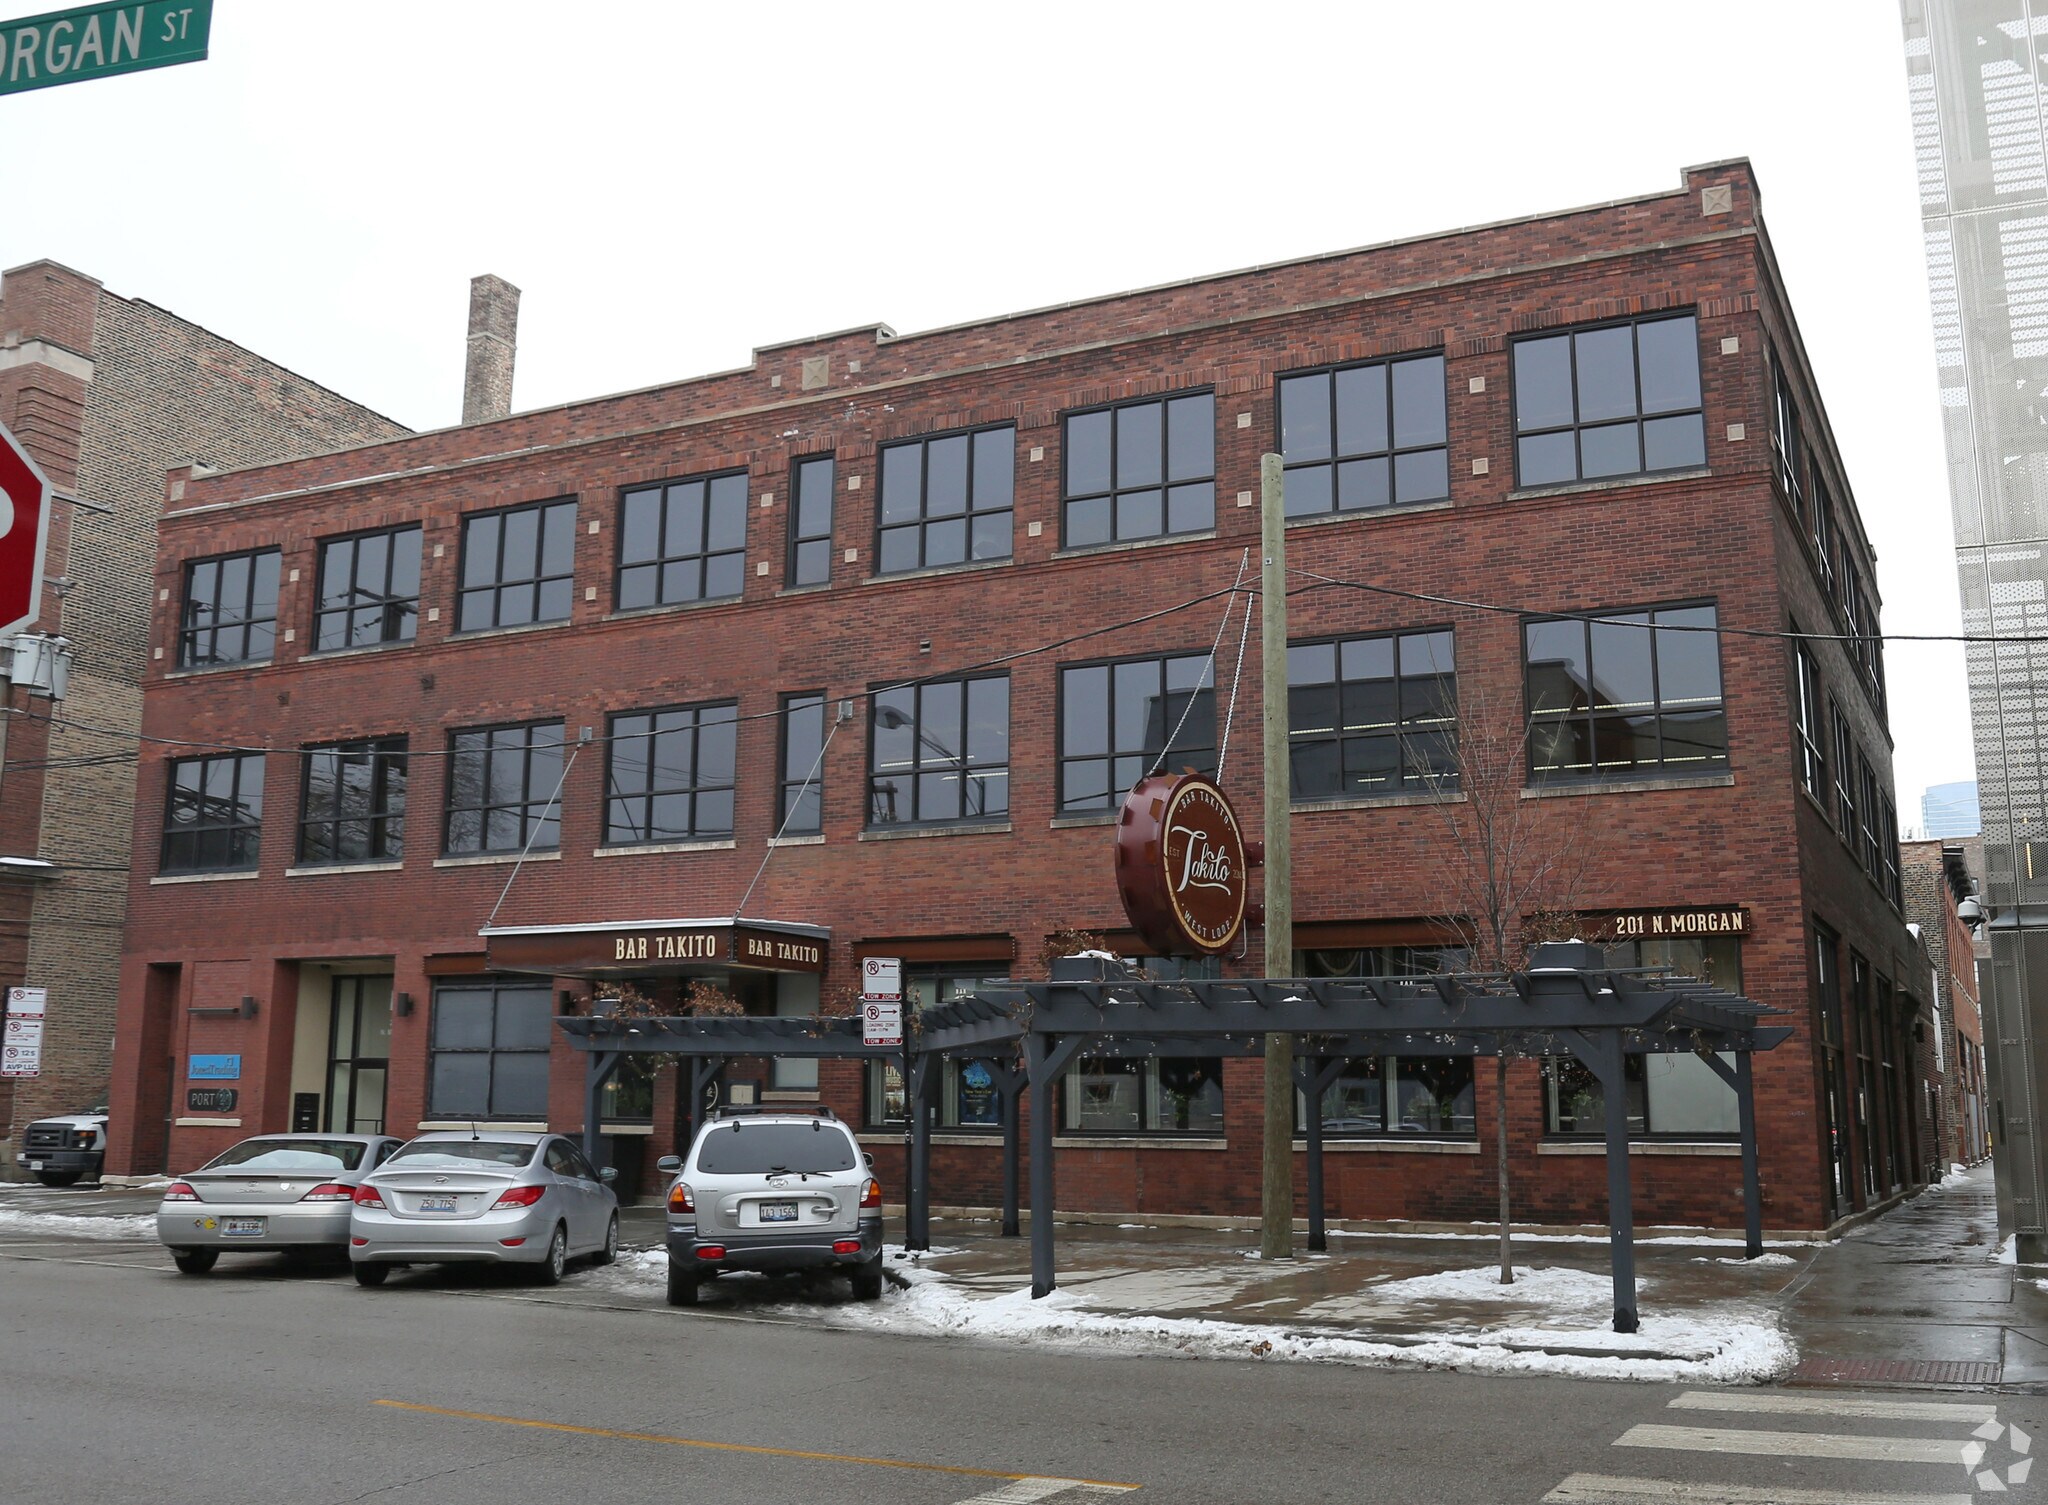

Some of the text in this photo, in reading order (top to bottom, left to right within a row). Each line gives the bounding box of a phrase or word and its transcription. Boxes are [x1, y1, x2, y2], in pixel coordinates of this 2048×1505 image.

[0, 6, 193, 82] RGAN ST
[1180, 790, 1229, 824] BAR TAKITO
[1171, 825, 1232, 893] Takito
[1184, 909, 1231, 939] WEST LOOP
[1616, 915, 1644, 934] 201
[1670, 911, 1743, 933] MORGAN
[615, 934, 716, 960] BAR TAKITO
[748, 938, 819, 964] BAR TAKITO
[885, 1065, 901, 1077] LIV
[191, 1093, 215, 1106] PORT
